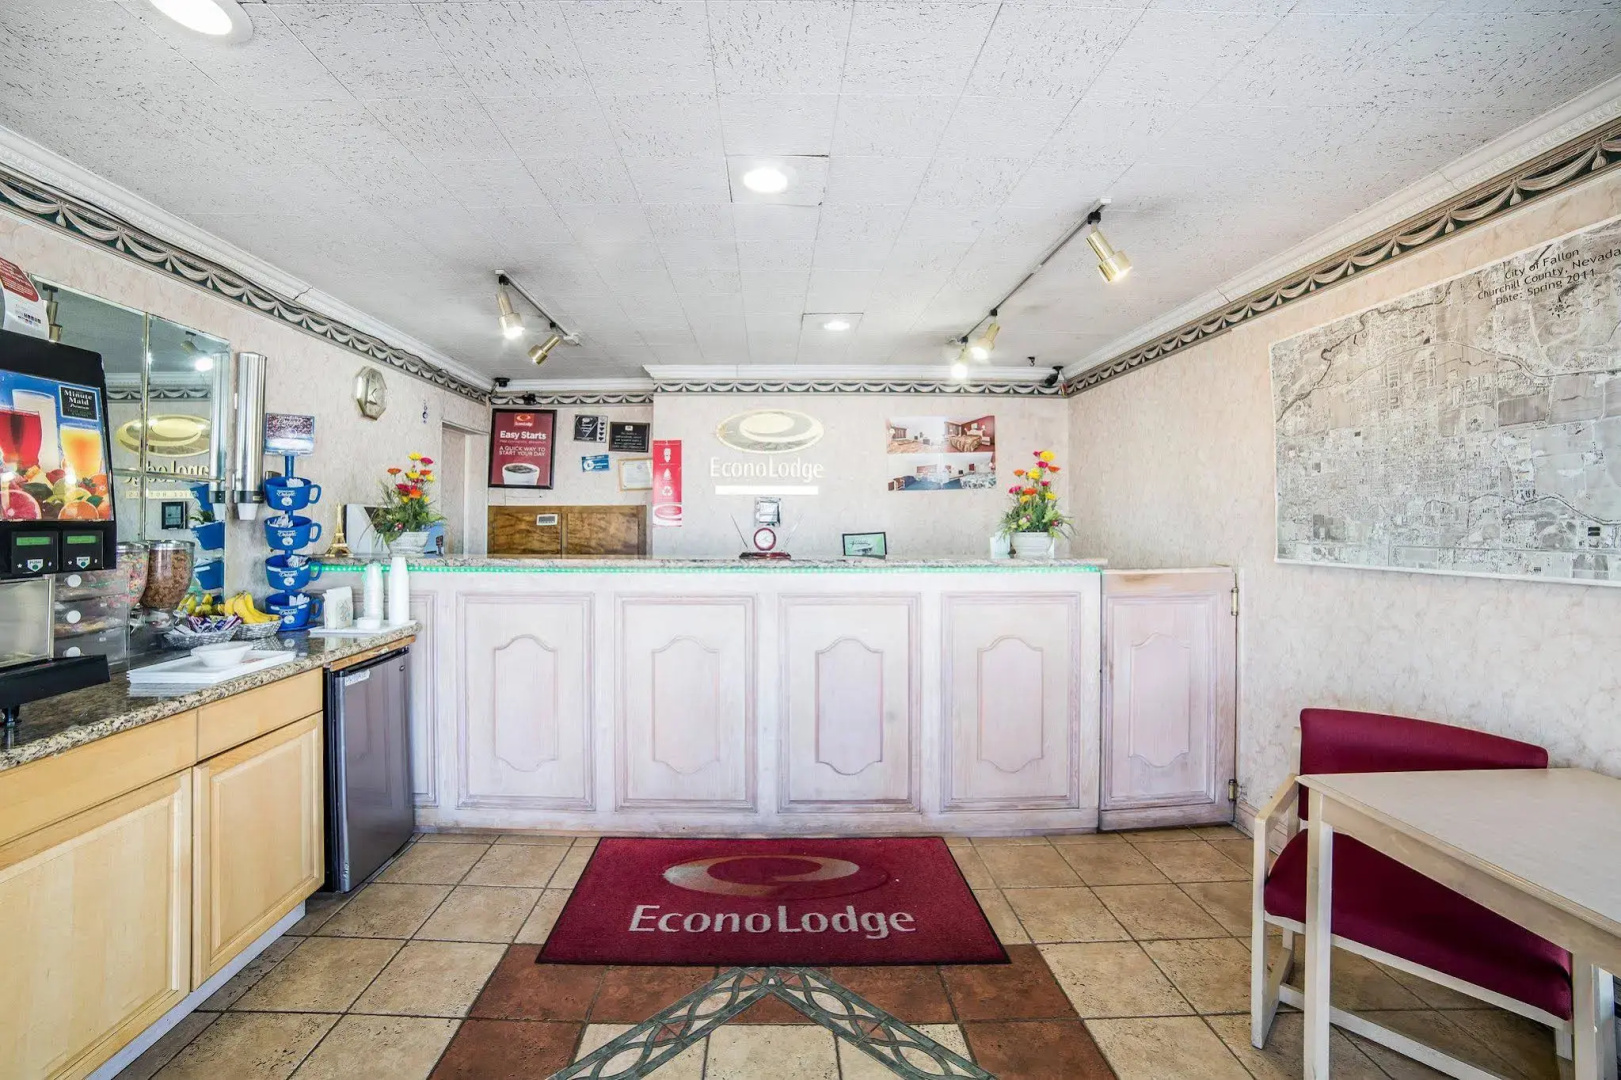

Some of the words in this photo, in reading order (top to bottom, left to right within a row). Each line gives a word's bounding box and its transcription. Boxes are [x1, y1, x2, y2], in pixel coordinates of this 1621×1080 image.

[1477, 280, 1520, 300] Churchill
[1572, 248, 1621, 269] Nevada
[1505, 267, 1525, 280] City
[1529, 261, 1539, 271] of
[1543, 249, 1579, 267] Fallon
[1495, 292, 1522, 306] Date:
[1527, 280, 1562, 296] Spring
[1566, 268, 1595, 284] 2011
[64, 390, 92, 400] Minute
[69, 397, 89, 405] Maid
[500, 430, 520, 440] Easy
[521, 431, 546, 440] Starts
[710, 456, 823, 483] EconoLodge
[628, 904, 916, 939] EconoLodge
